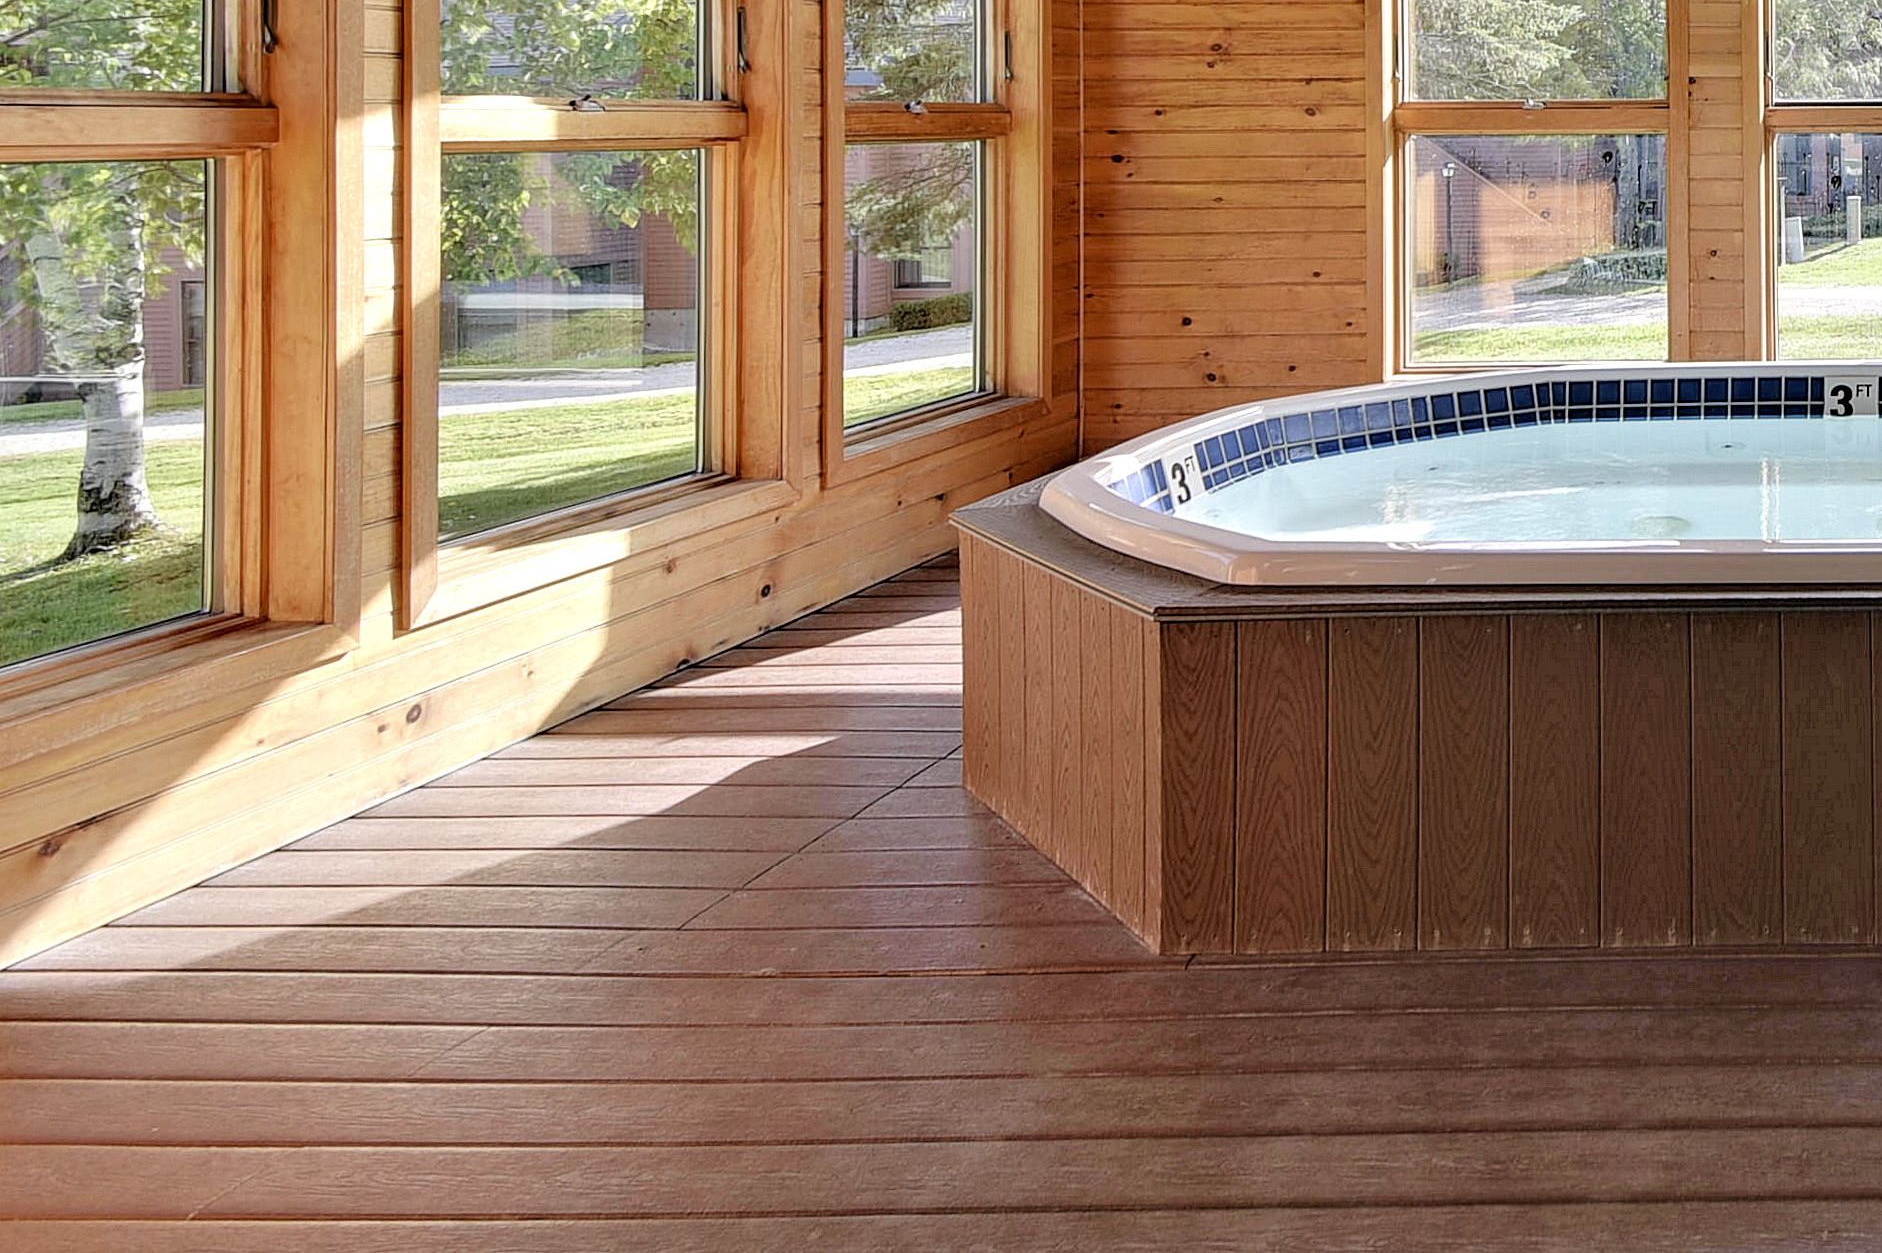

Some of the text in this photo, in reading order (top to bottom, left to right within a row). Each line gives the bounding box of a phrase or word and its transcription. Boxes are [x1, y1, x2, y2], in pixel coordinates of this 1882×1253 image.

[1830, 384, 1872, 416] 3 FT
[1172, 455, 1195, 504] 3 FT
